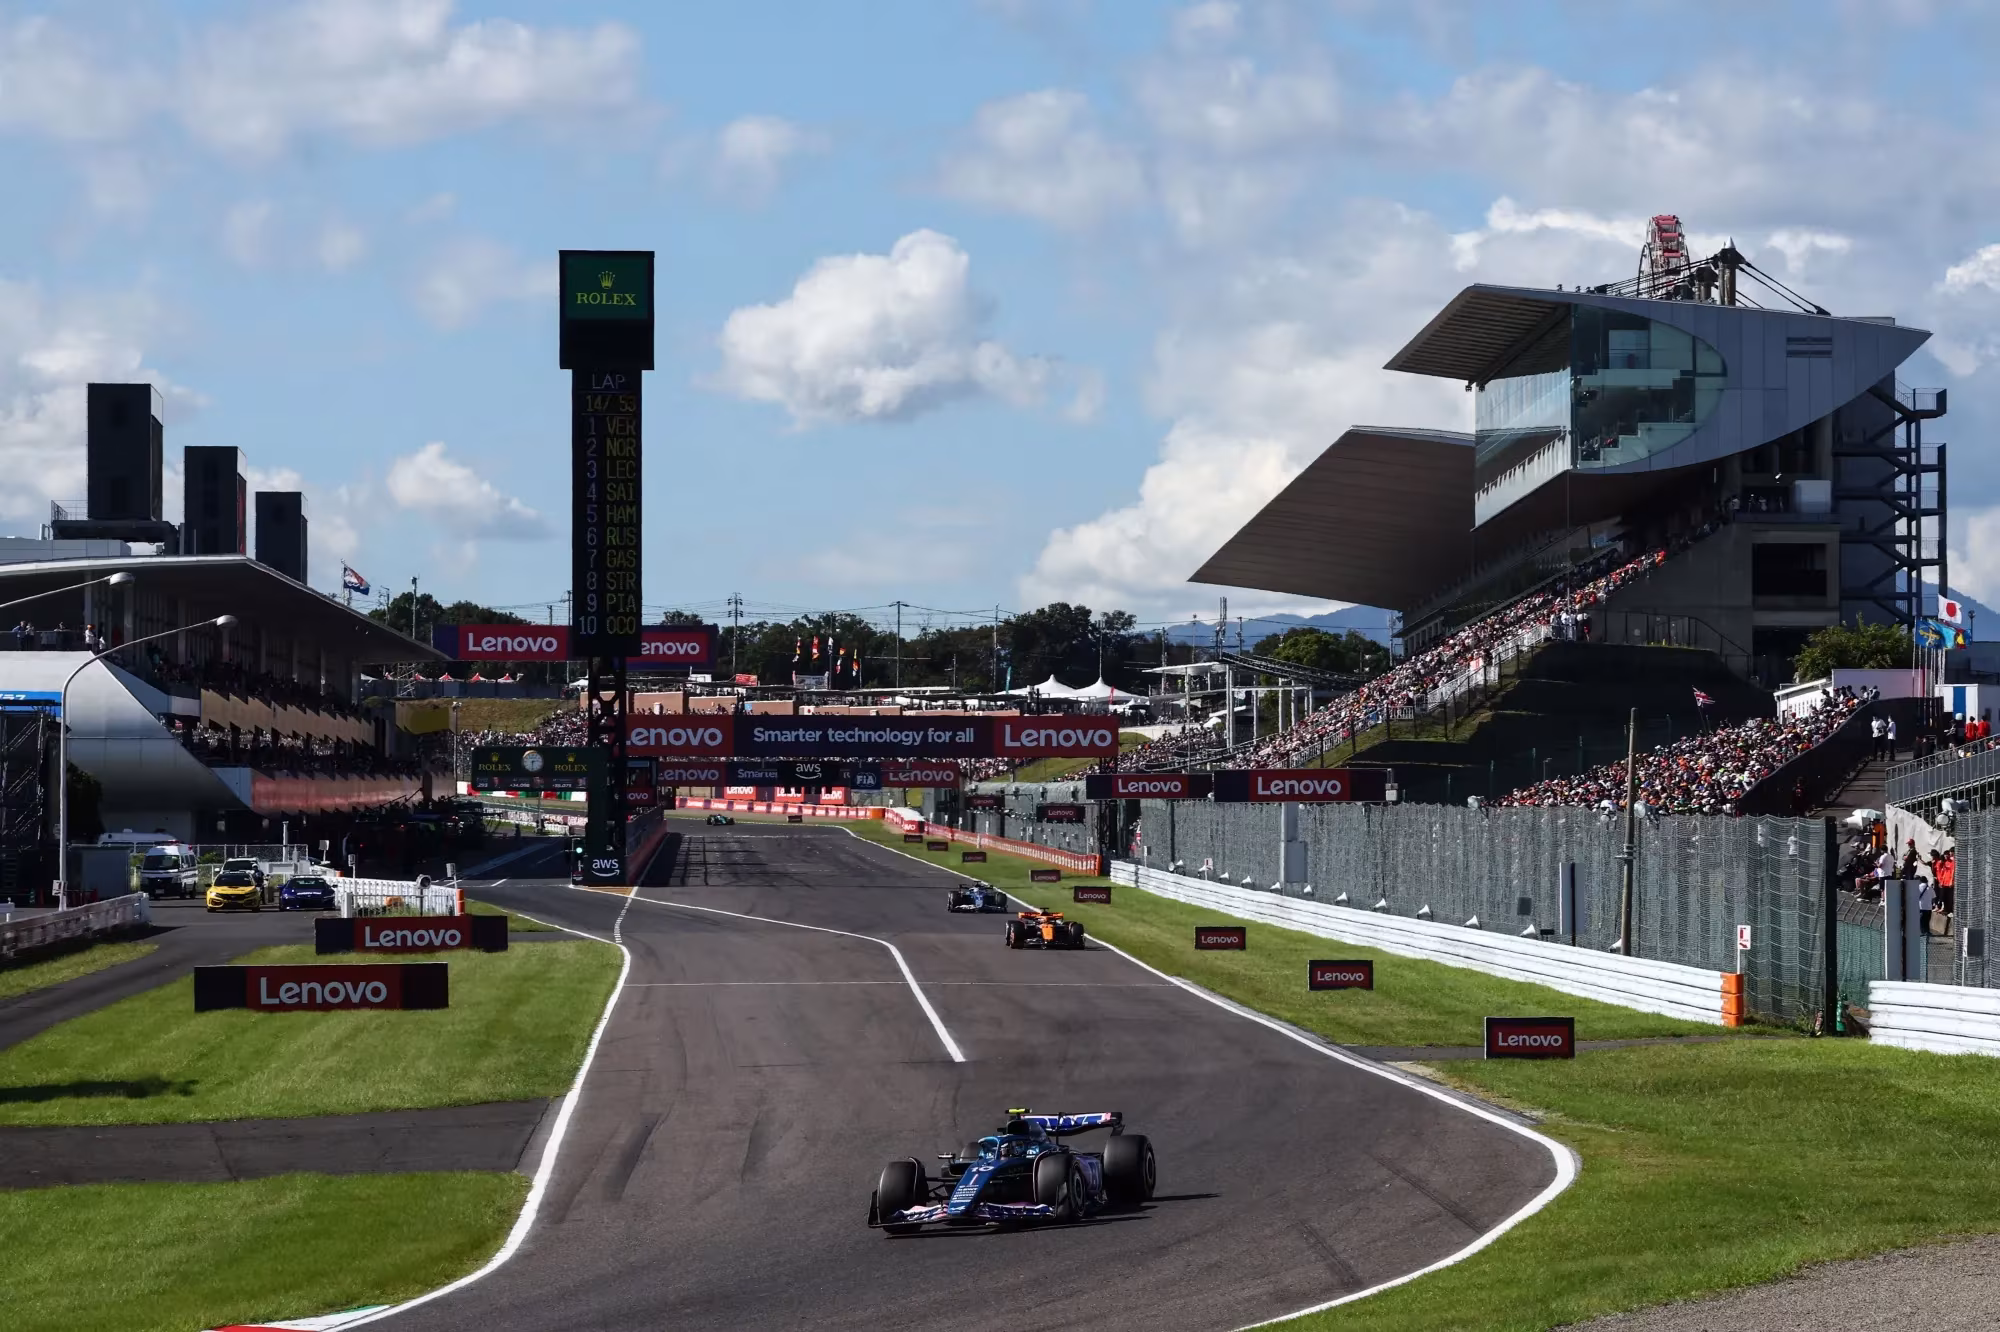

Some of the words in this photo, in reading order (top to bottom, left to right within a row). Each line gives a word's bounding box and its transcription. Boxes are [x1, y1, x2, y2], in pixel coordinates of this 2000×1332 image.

[576, 292, 637, 306] ROLEX
[592, 374, 625, 390] LAP
[588, 416, 597, 436] 1
[606, 416, 637, 436] VER
[586, 437, 597, 457] 2
[606, 437, 637, 457] NOR
[586, 460, 597, 479] 3
[606, 460, 637, 479] LEC
[586, 482, 597, 501] 4
[606, 482, 635, 501] SAI
[586, 504, 597, 523] 5
[606, 504, 637, 523] HAM
[586, 526, 597, 546] 6
[606, 526, 637, 546] RUS
[586, 549, 597, 568] 7
[606, 549, 637, 568] GAS
[586, 571, 597, 590] 8
[606, 571, 637, 590] STR
[586, 593, 597, 613] 9
[606, 593, 637, 613] PIA
[579, 615, 597, 635] 10
[468, 632, 558, 653] Lenovo
[641, 641, 700, 655] enovo
[753, 727, 823, 743] Smarter
[827, 727, 924, 746] technology
[927, 727, 952, 743] for
[955, 727, 974, 743] all
[1004, 724, 1112, 747] Lenovo
[478, 763, 511, 772] ROLEX
[554, 764, 588, 772] ROLEX
[796, 763, 821, 773] aws
[856, 775, 875, 785] FIA
[1118, 778, 1182, 793] Lenovo
[1257, 776, 1342, 796] Lenovo
[592, 858, 619, 869] aws
[1078, 891, 1107, 900] Lenovo
[364, 925, 462, 948] Lenovo
[1201, 934, 1239, 944] Lenovo
[1317, 970, 1365, 982] Lenovo
[260, 976, 388, 1005] Lenovo
[1498, 1031, 1562, 1047] Lenovo
[971, 1165, 995, 1173] 10
